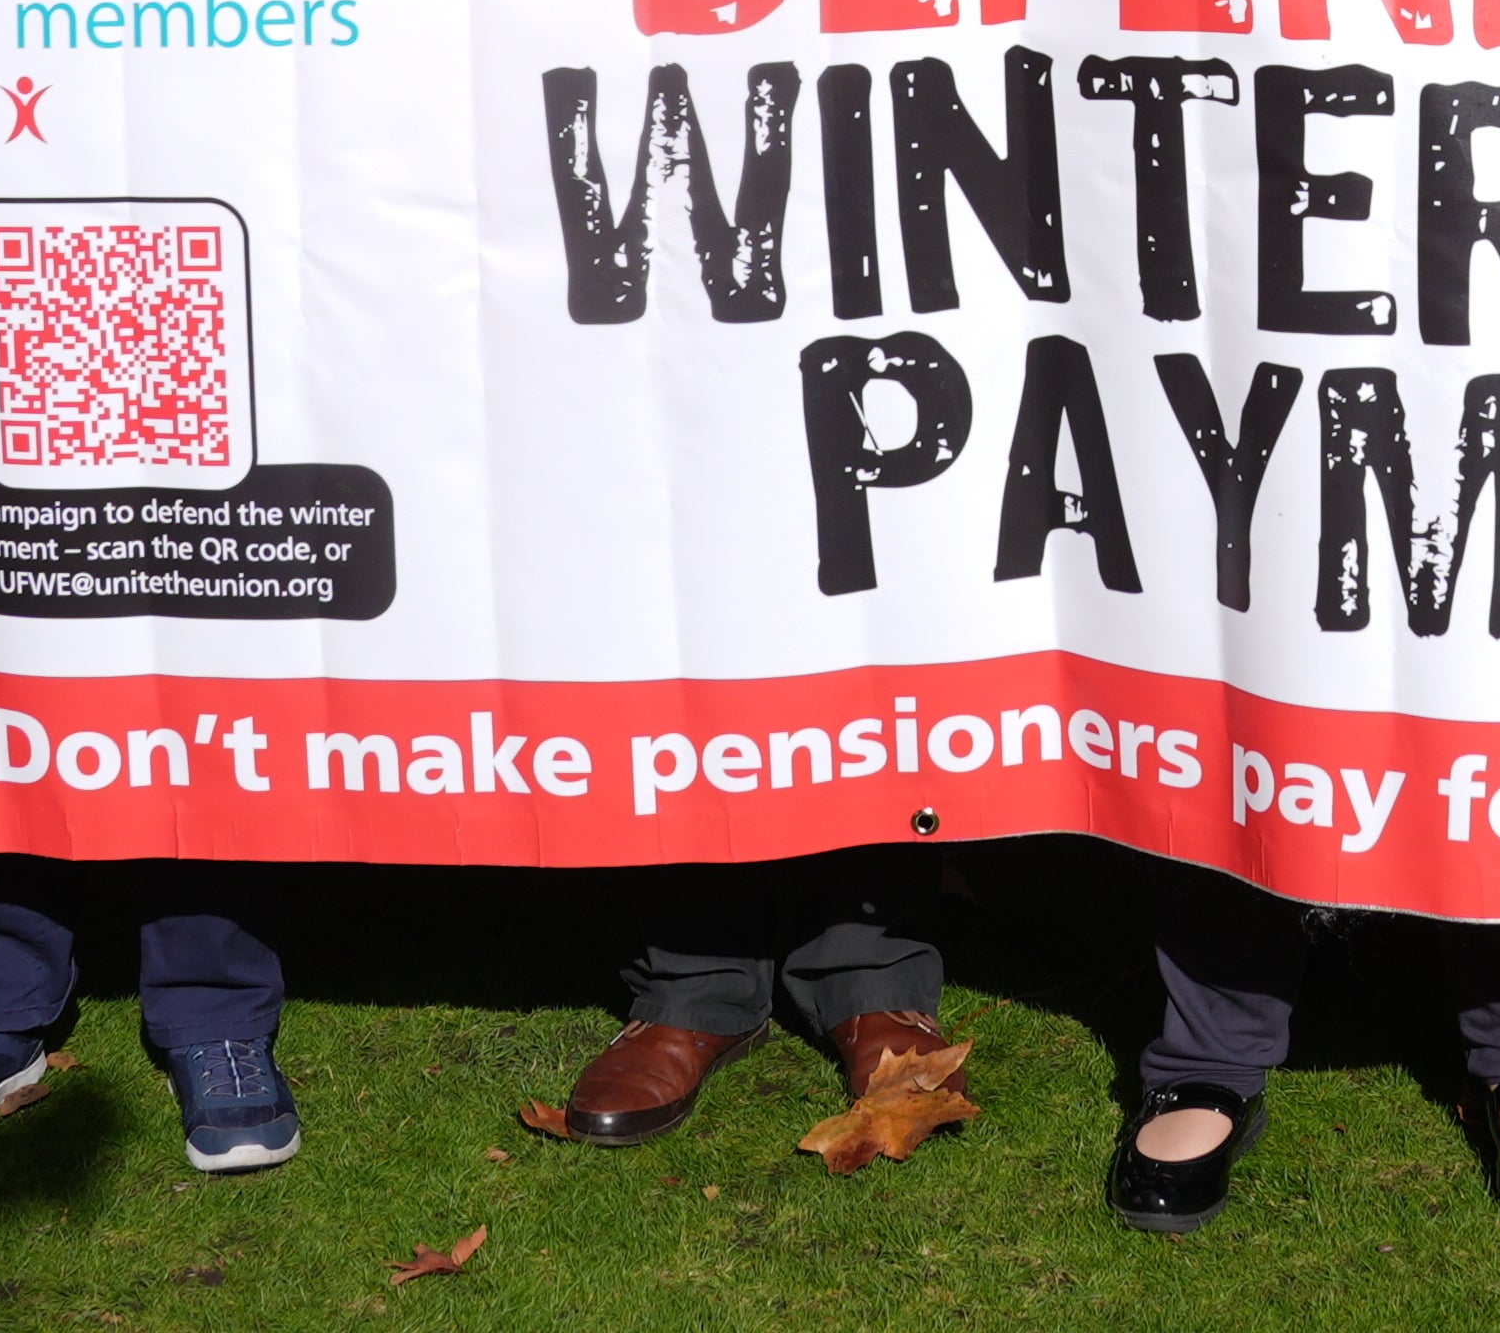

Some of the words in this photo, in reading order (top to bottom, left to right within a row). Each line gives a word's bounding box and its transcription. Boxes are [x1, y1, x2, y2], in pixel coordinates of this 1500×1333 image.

[104, 503, 134, 525] to
[141, 498, 231, 526] defend
[236, 501, 284, 527] the
[290, 501, 375, 527] winter
[86, 536, 146, 560] scan
[151, 535, 194, 560] the
[199, 538, 238, 563] QR
[245, 536, 318, 565] code,
[324, 542, 352, 562] or
[307, 712, 592, 797] make
[630, 696, 1204, 816] pensioners
[1230, 741, 1405, 854] pay
